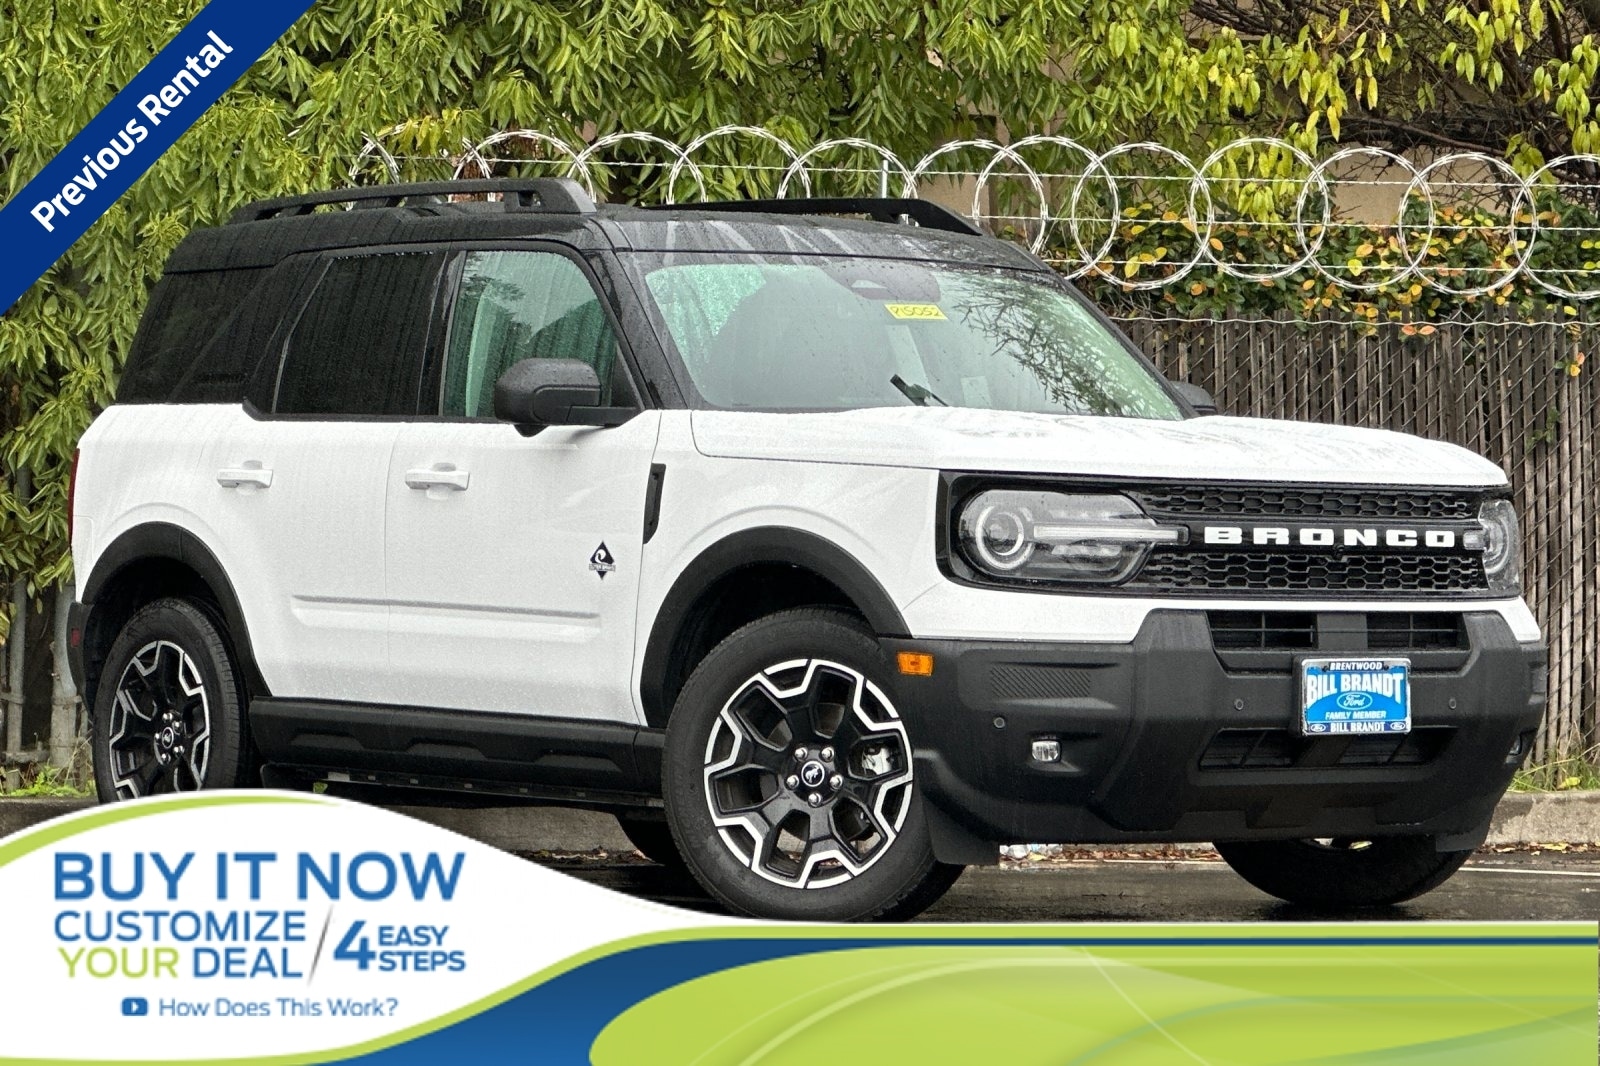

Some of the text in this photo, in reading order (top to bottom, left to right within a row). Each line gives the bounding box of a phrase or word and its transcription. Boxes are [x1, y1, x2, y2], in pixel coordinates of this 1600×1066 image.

[1204, 526, 1455, 547] BRONCO
[1330, 661, 1382, 671] BRENTWOOD
[1306, 673, 1404, 710] BILL BRANDT
[1343, 694, 1366, 706] Ford
[1325, 710, 1387, 720] FAMILY MEMBER
[1330, 722, 1350, 732] BILL
[1351, 721, 1385, 732] BRANDT
